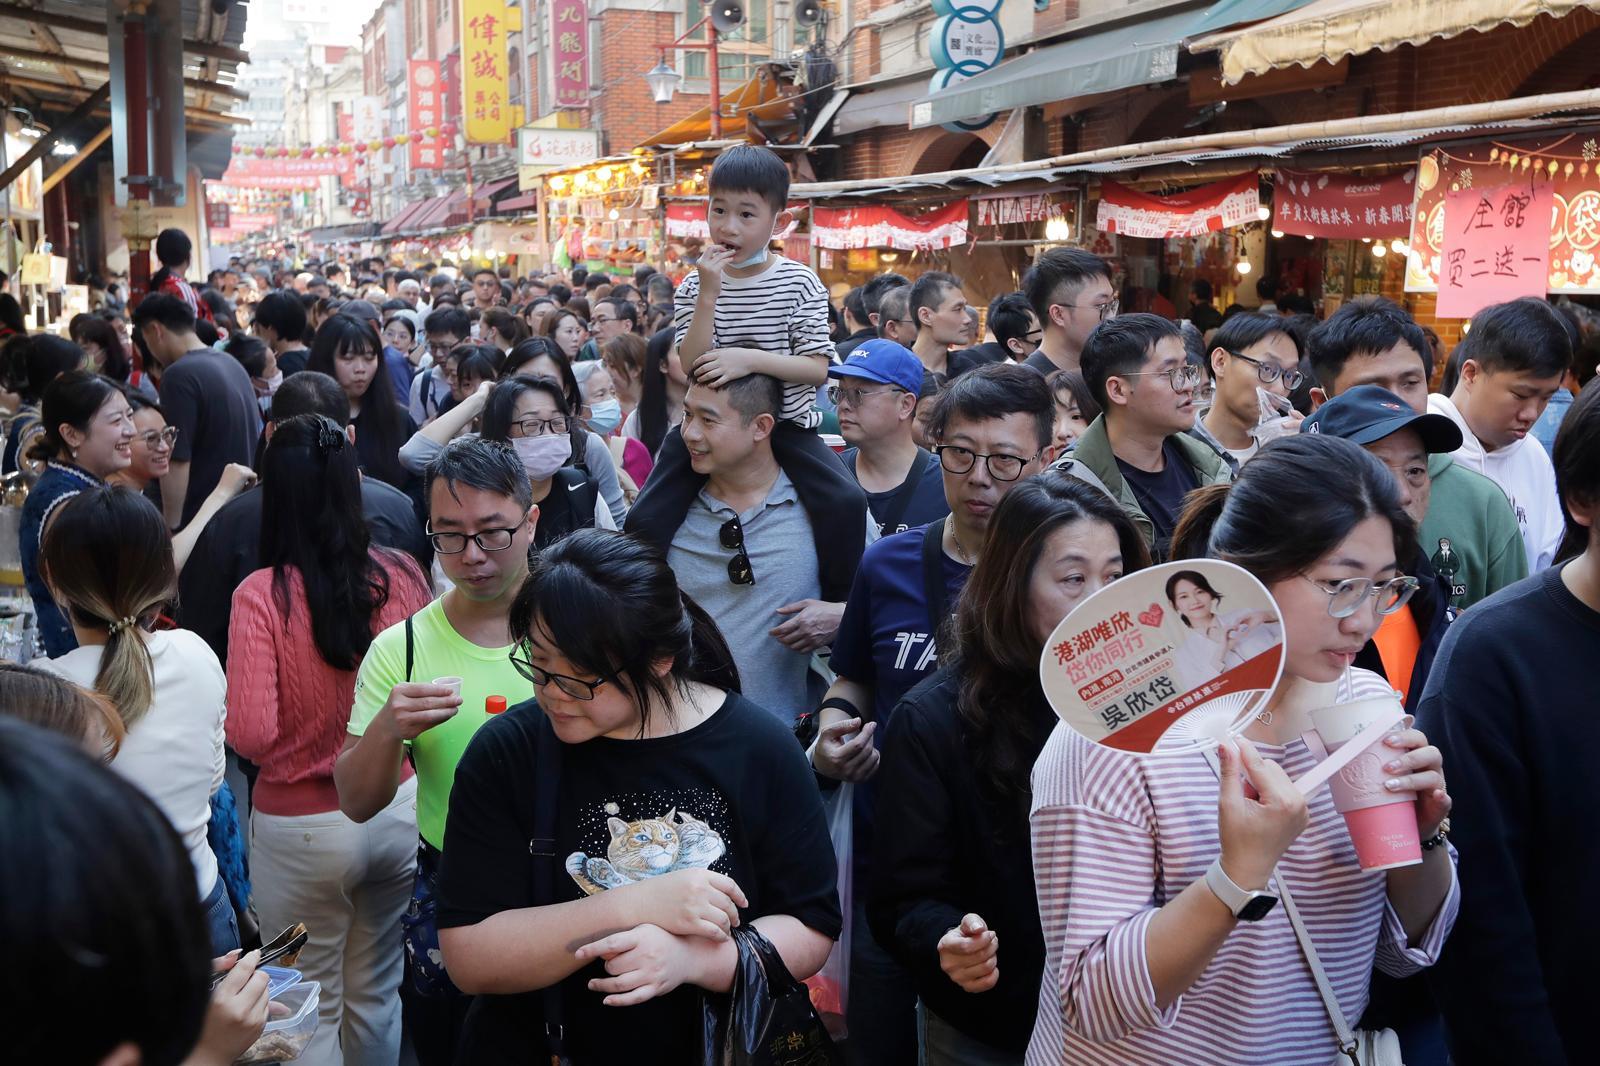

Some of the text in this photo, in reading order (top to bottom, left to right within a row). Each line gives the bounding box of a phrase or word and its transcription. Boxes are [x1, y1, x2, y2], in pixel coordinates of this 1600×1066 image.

[469, 14, 503, 82] 偉誠
[1464, 191, 1531, 235] 全館
[1447, 243, 1541, 289] 買二送一
[1053, 611, 1135, 666] 港湖唯欣
[1064, 628, 1145, 685] 岱你同行
[1100, 676, 1177, 730] 吳欣岱
